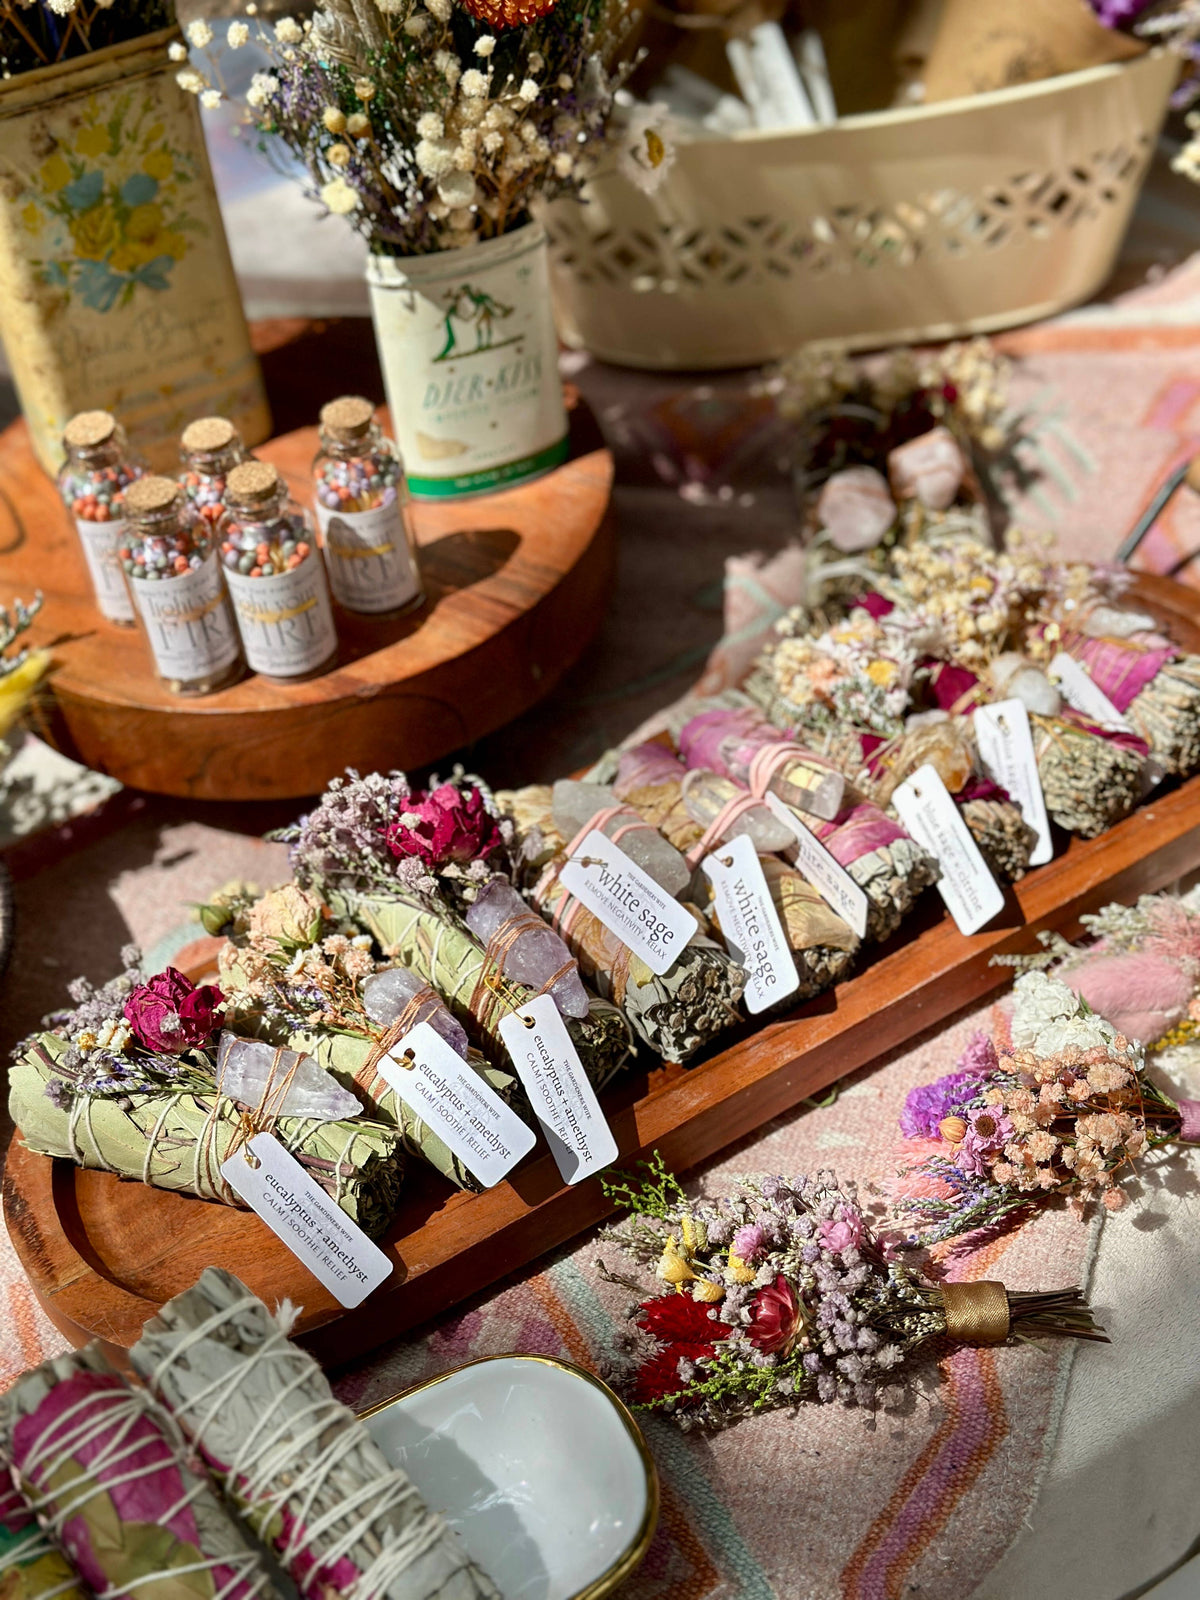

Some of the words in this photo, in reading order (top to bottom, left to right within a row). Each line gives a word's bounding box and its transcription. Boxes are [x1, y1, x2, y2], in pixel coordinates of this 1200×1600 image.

[584, 880, 609, 905] REMOVE
[607, 902, 644, 938] NEGATIVITY
[645, 939, 668, 960] RELAX
[598, 866, 640, 913] white
[638, 908, 675, 945] sage
[720, 880, 735, 917] REMOVE
[731, 911, 752, 963] NEGATIVITY
[751, 970, 765, 999] RELAX
[733, 877, 760, 937] white
[753, 939, 777, 988] sage
[414, 1081, 437, 1105] CALM
[436, 1105, 467, 1136] SOOTHE
[466, 1137, 491, 1161] RELIEF
[419, 1063, 466, 1110] eucalyptus
[469, 1115, 512, 1160] amethyst
[457, 1074, 467, 1086] THE
[465, 1083, 490, 1110] GARDENERS
[487, 1107, 502, 1120] WIFE
[526, 1052, 541, 1080] CALM
[540, 1083, 562, 1122] SOOTHE
[558, 1127, 575, 1156] RELIEF
[533, 1034, 566, 1098] eucalyptus
[564, 1106, 594, 1163] amethyst
[563, 1059, 572, 1073] THE
[568, 1071, 587, 1106] GARDENERS
[582, 1103, 593, 1120] WIFE
[262, 1192, 285, 1217] CALM
[287, 1219, 320, 1254] SOOTHE
[322, 1255, 348, 1281] RELIEF
[265, 1173, 318, 1228] eucalyptus
[322, 1235, 369, 1284] amethyst
[304, 1190, 315, 1202] THE
[313, 1201, 342, 1232] GARDENERS
[340, 1229, 354, 1243] WIFE
